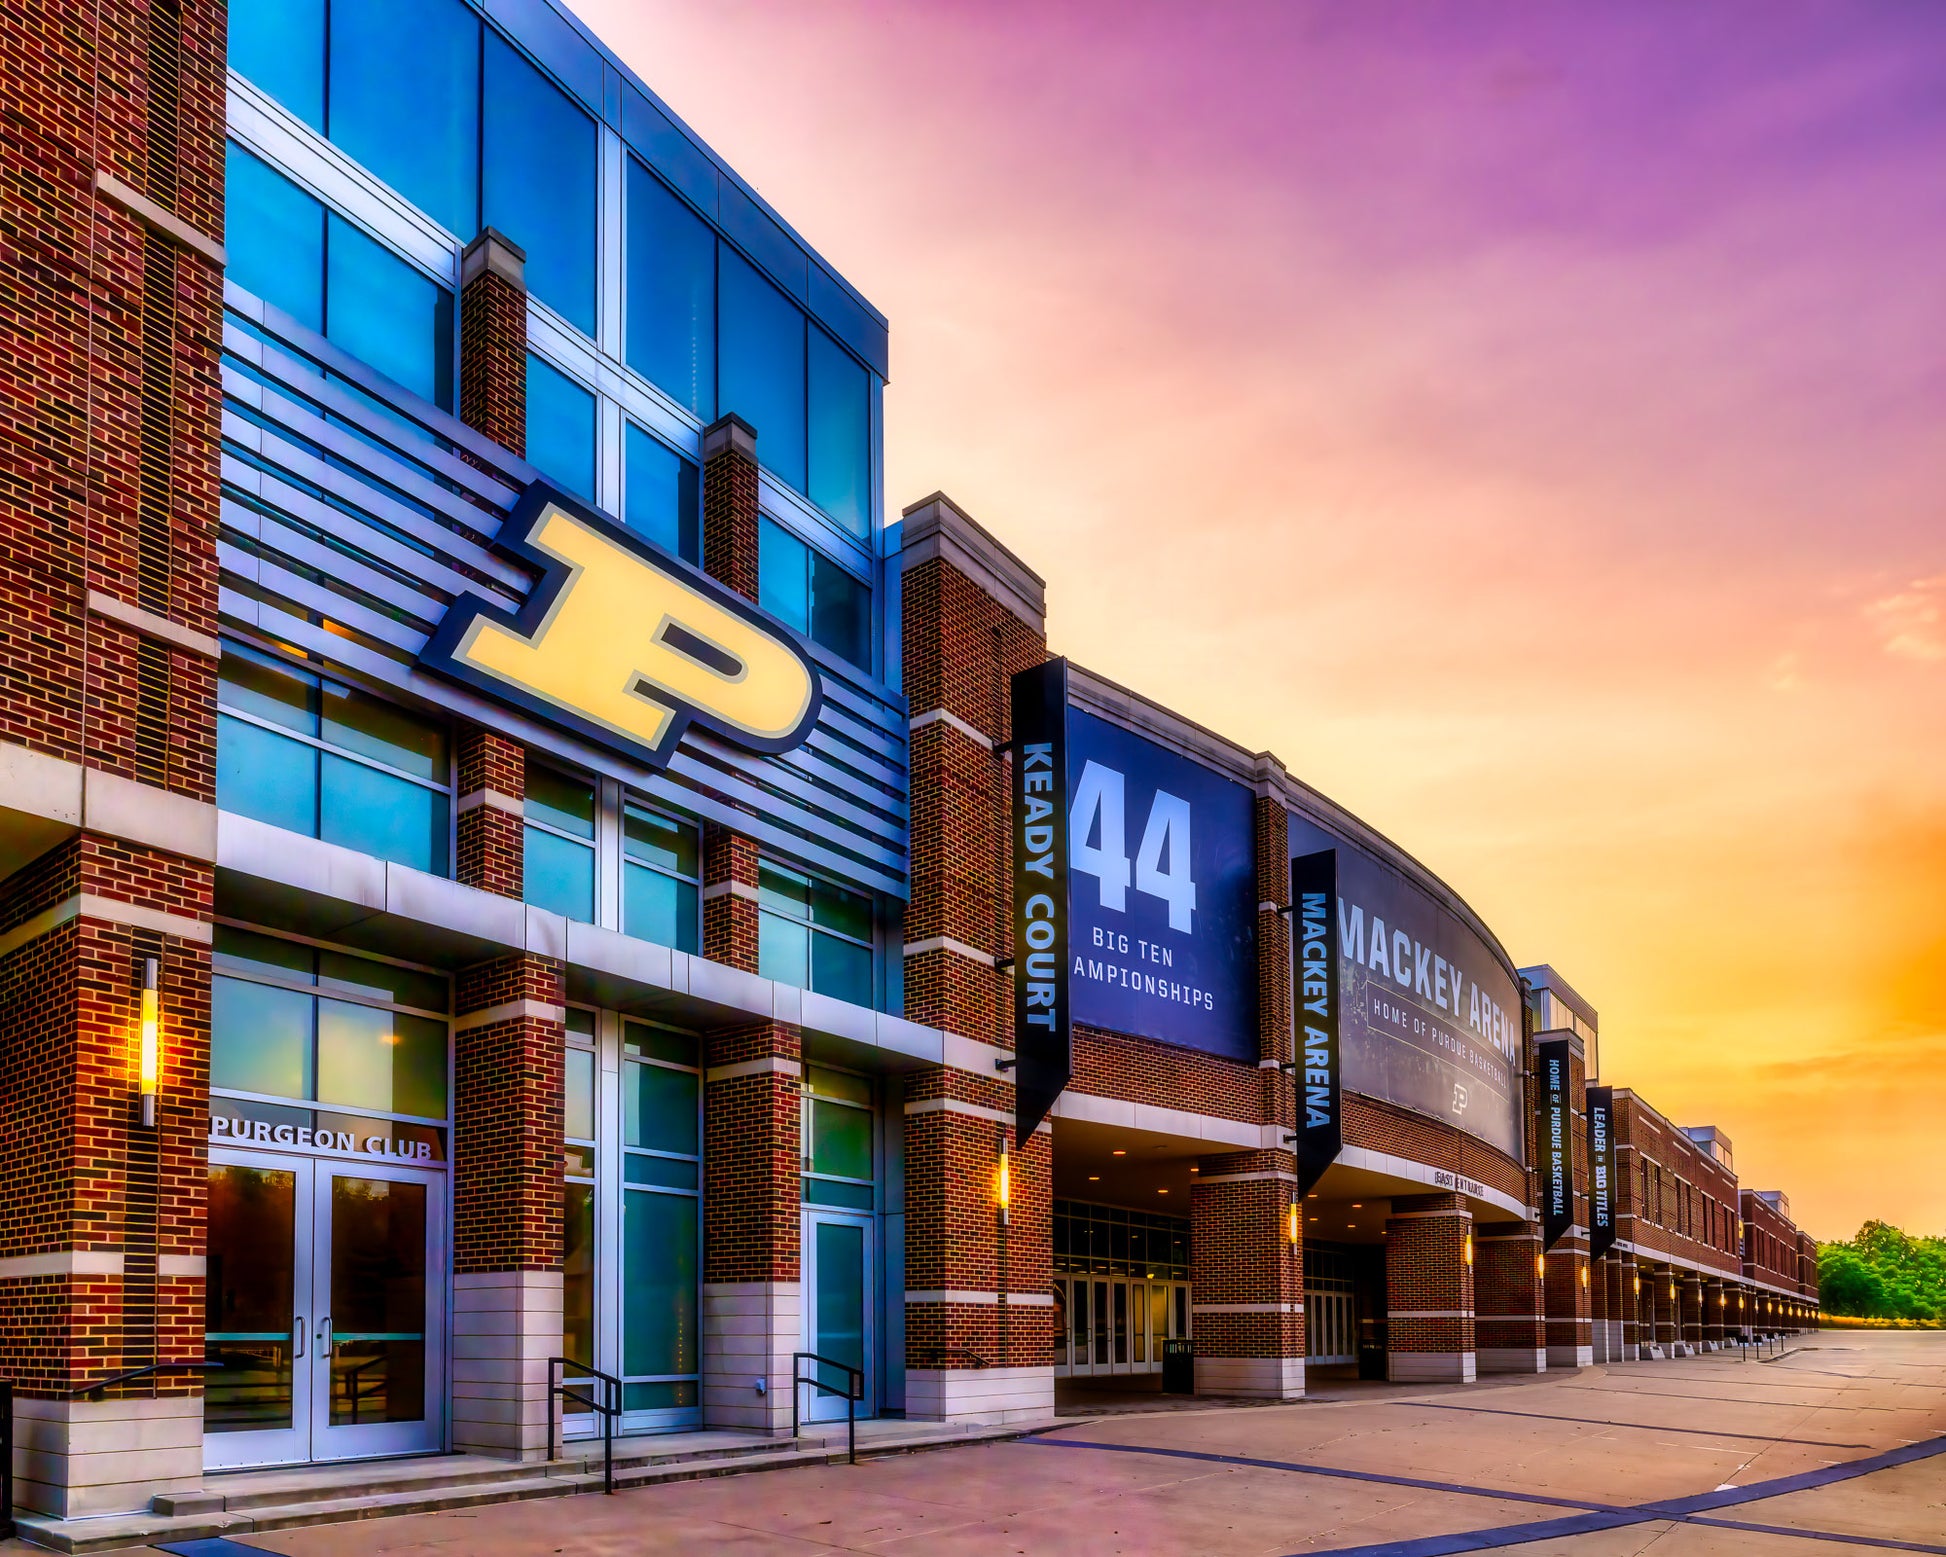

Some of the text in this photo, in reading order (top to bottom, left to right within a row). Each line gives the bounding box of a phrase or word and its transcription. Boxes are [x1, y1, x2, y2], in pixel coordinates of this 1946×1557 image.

[440, 494, 818, 758] P
[1023, 742, 1056, 1032] KEADY COURT
[1069, 759, 1197, 935] 44
[1092, 926, 1173, 967] BIG TEN
[1338, 896, 1516, 1067] MACKEY ARENA
[1302, 893, 1331, 1129] MACKEY ARENA
[1373, 998, 1507, 1089] HOME OF PURDUE BASKETBALL
[365, 1135, 432, 1161] CLUB
[1435, 1171, 1453, 1187] EAST
[1549, 1059, 1563, 1216] HOME OF PURDUE BASKETBALL
[1594, 1107, 1607, 1152] LEADER
[1595, 1190, 1608, 1228] TITLES
